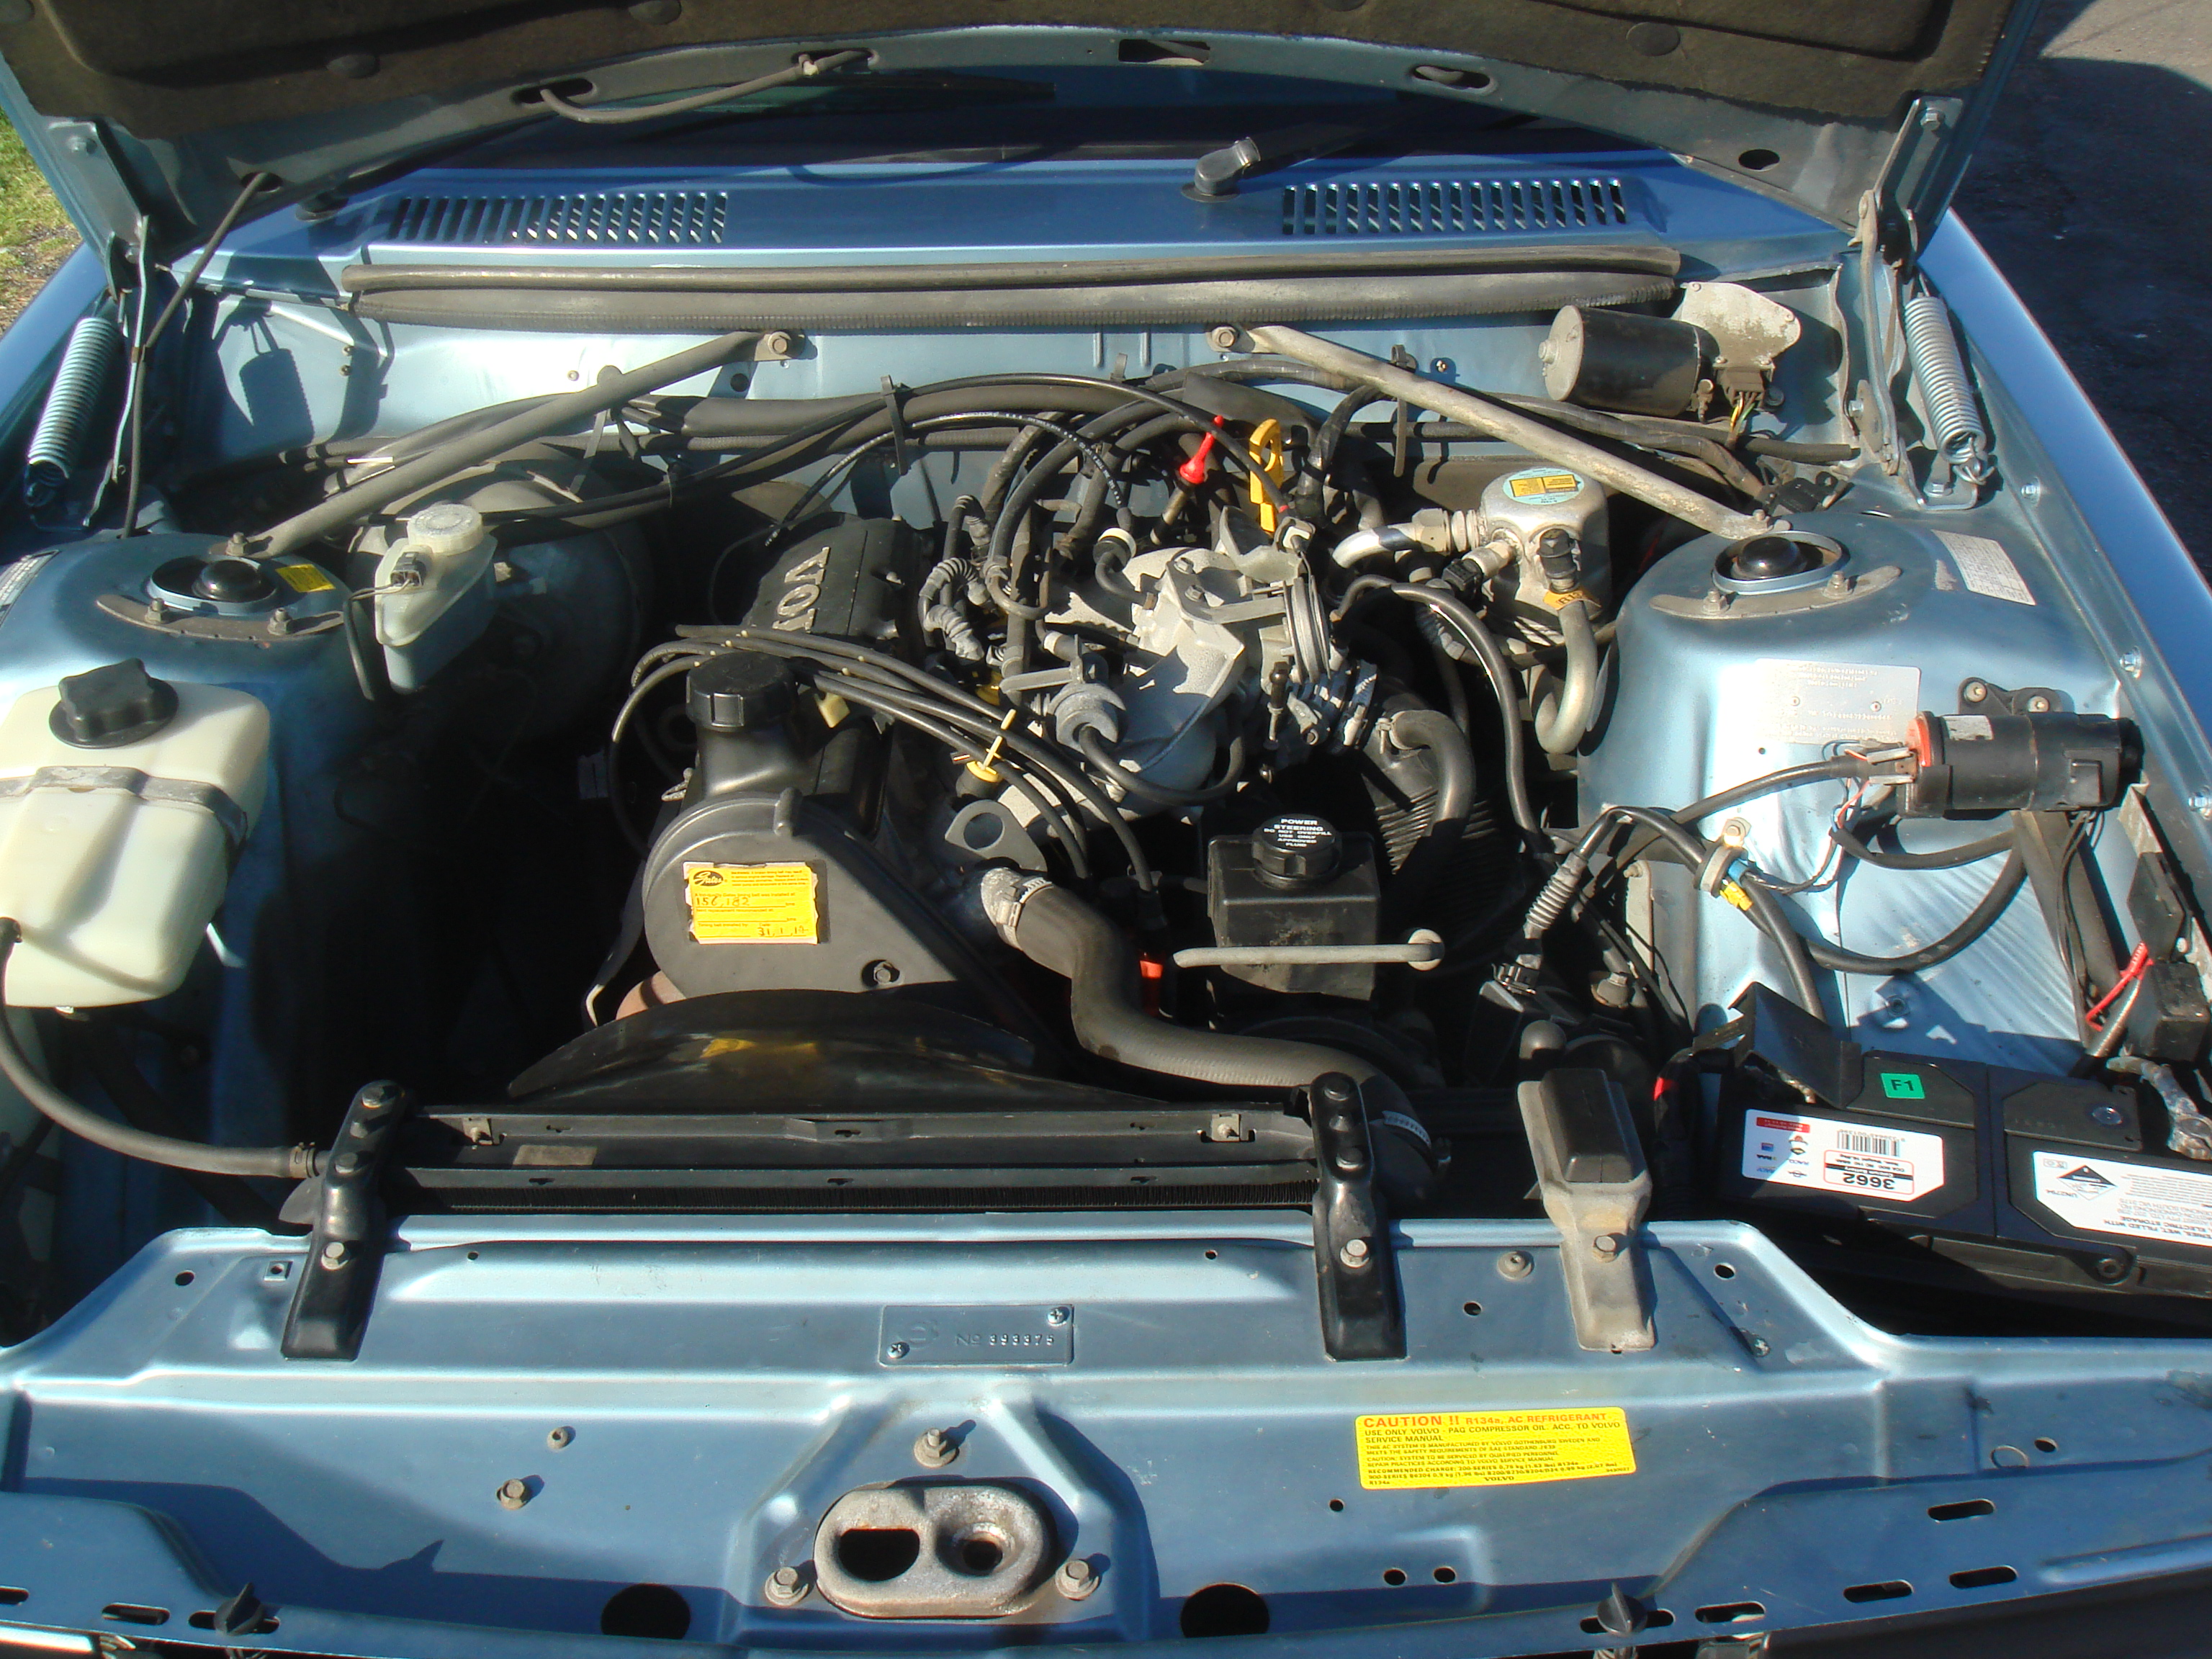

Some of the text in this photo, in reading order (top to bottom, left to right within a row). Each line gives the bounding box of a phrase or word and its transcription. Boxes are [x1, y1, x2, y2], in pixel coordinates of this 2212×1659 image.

[772, 546, 830, 634] VOL
[1891, 1079, 1914, 1092] F1
[1843, 1173, 1895, 1190] 3662
[1364, 1416, 1442, 1427] CAUTION
[1527, 1413, 1606, 1422] REFRIGERANT
[1469, 1424, 1529, 1433] COMPRESSOR
